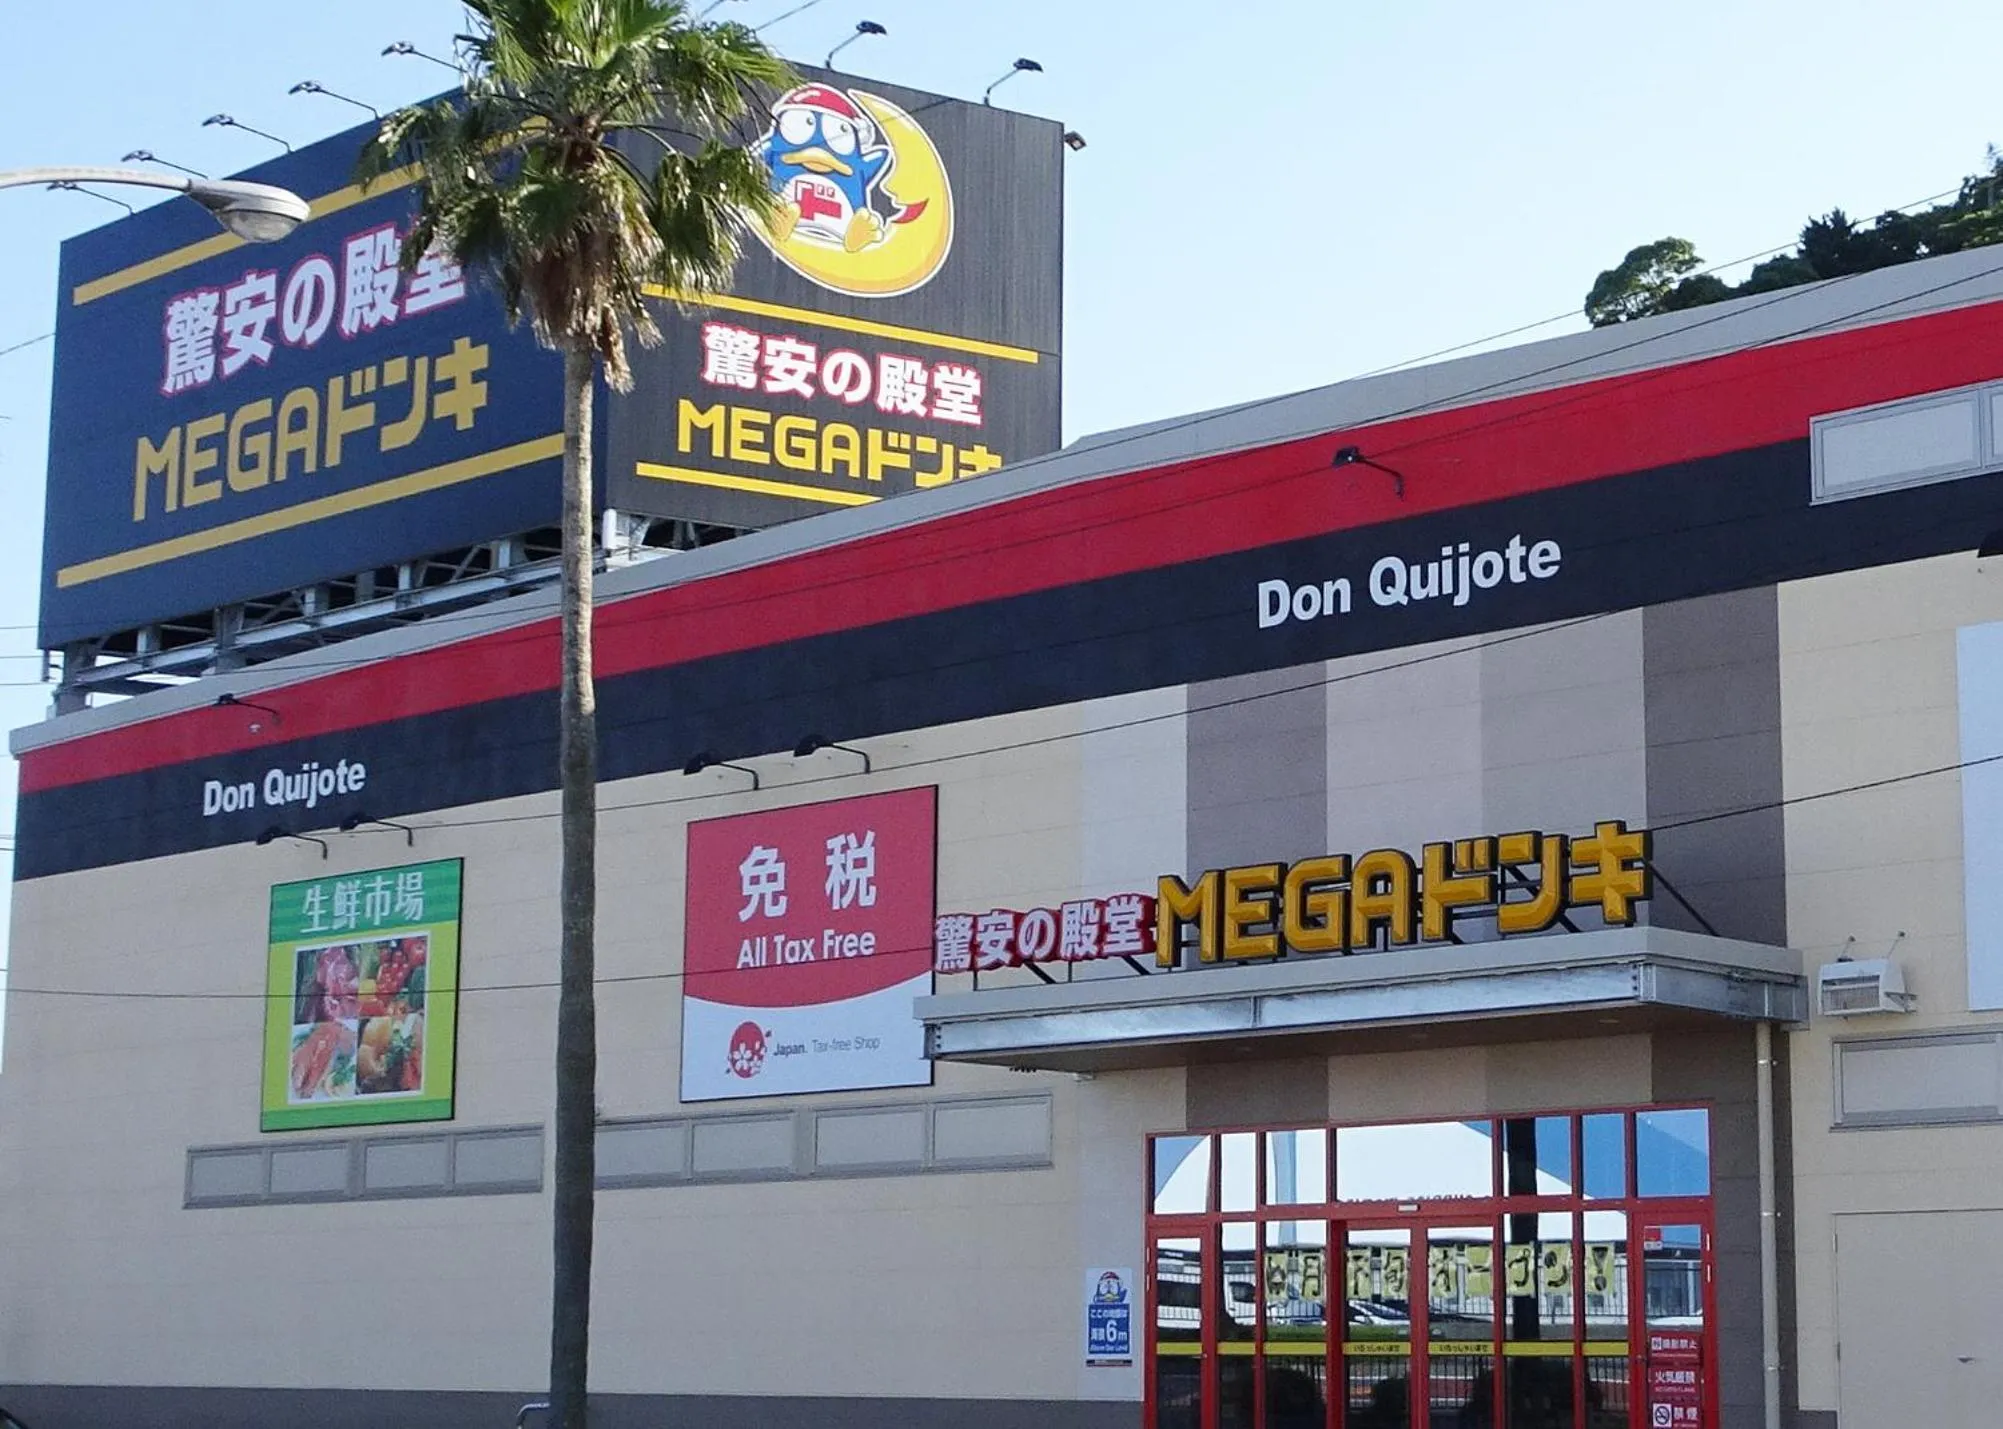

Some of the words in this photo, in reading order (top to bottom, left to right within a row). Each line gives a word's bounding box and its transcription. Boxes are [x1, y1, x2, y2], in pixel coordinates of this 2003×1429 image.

[702, 323, 982, 426] 驚安の殿堂
[133, 337, 489, 522] MEGAドンキ
[1258, 577, 1351, 628] Don
[1369, 533, 1562, 607] Quijote
[203, 780, 255, 816] Don
[263, 759, 366, 808] Quijote
[300, 871, 425, 934] 生鮮市場
[737, 829, 877, 923] 免税
[934, 894, 1144, 972] 驚安の殿堂
[1156, 821, 1652, 967] MEGAドンキ
[736, 936, 767, 969] All
[773, 934, 814, 965] Tax
[823, 929, 876, 960] Free
[812, 1038, 852, 1053] Tax-free
[855, 1036, 881, 1052] Shop
